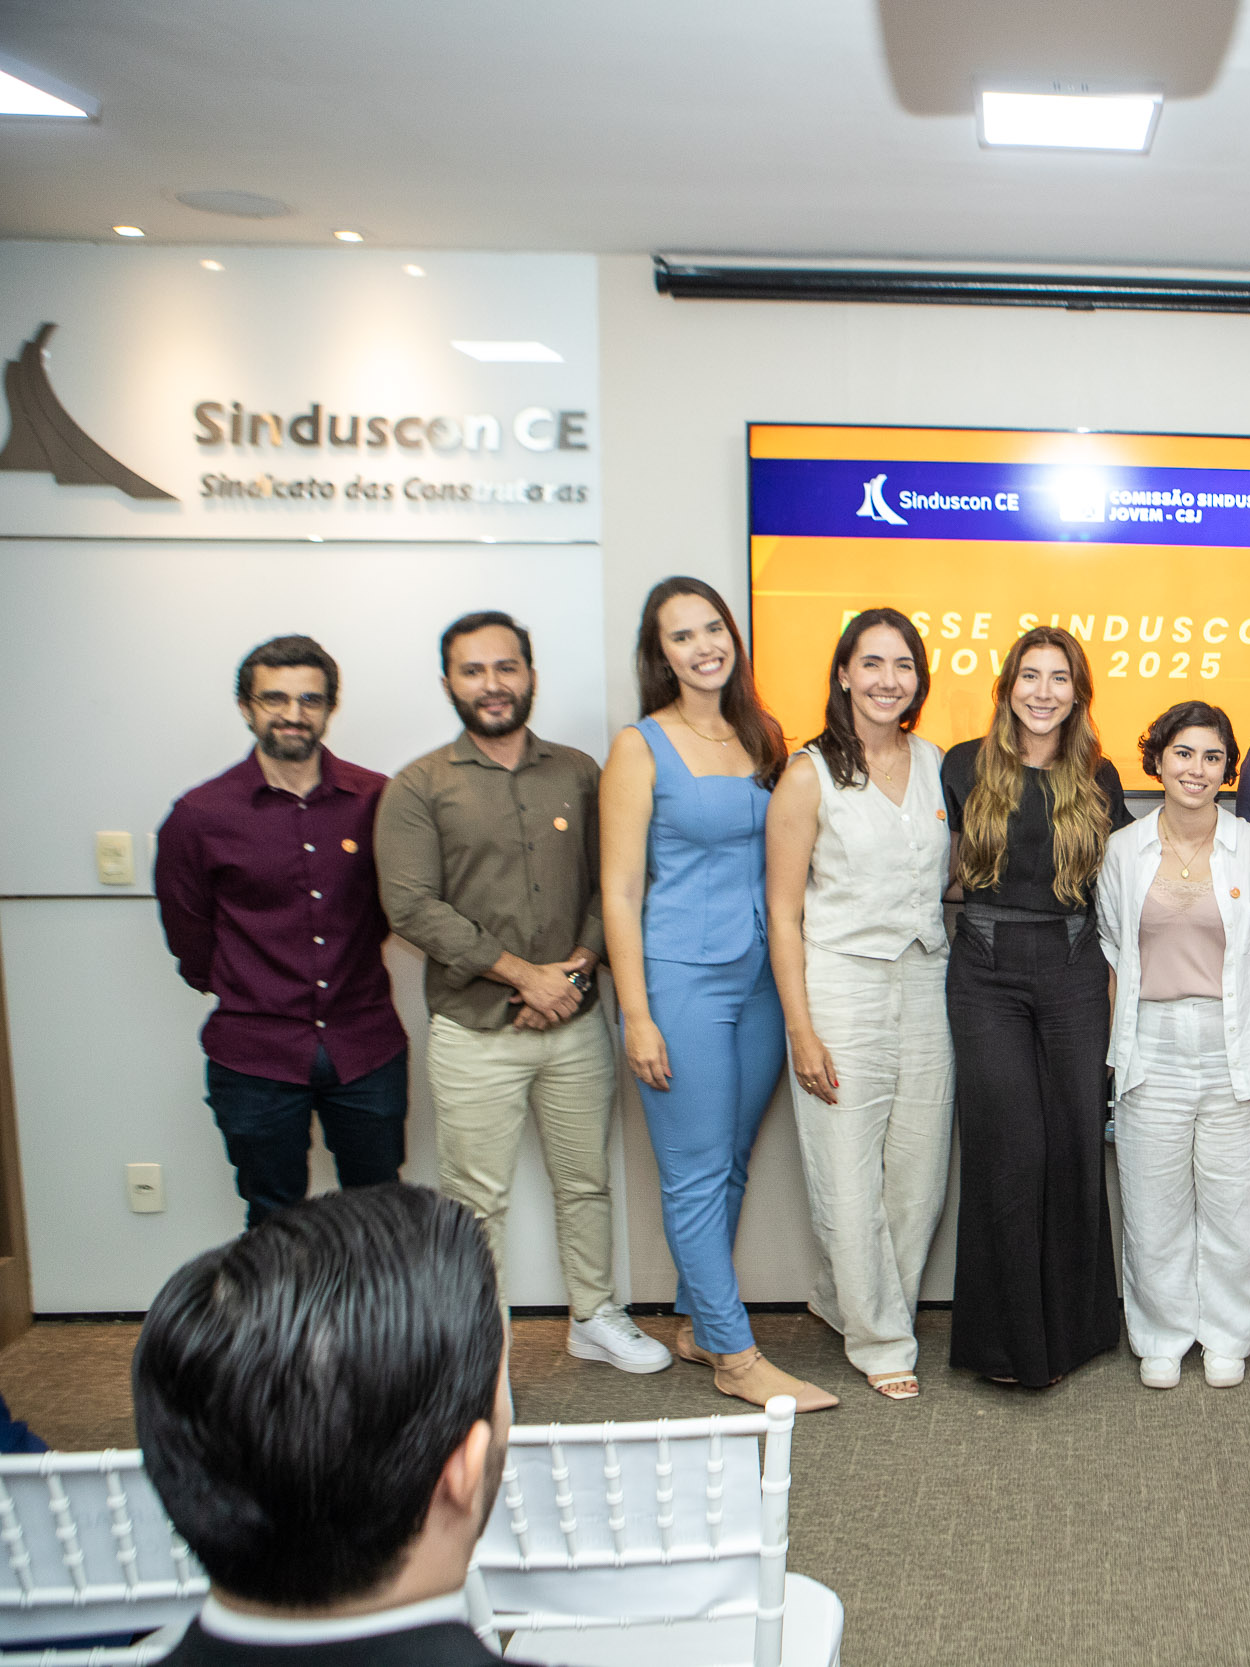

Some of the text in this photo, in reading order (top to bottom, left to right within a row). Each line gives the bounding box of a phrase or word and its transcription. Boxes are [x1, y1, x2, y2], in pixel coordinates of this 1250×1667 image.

[193, 401, 589, 452] Sinduscon CE
[344, 474, 395, 500] das
[1108, 489, 1196, 507] COMISSÃO
[899, 490, 1020, 512] Sinduscon CE
[1108, 507, 1164, 522] JOVEM
[1175, 509, 1203, 524] CSJ
[841, 610, 993, 640] PSSE
[1107, 650, 1222, 680] 2025
